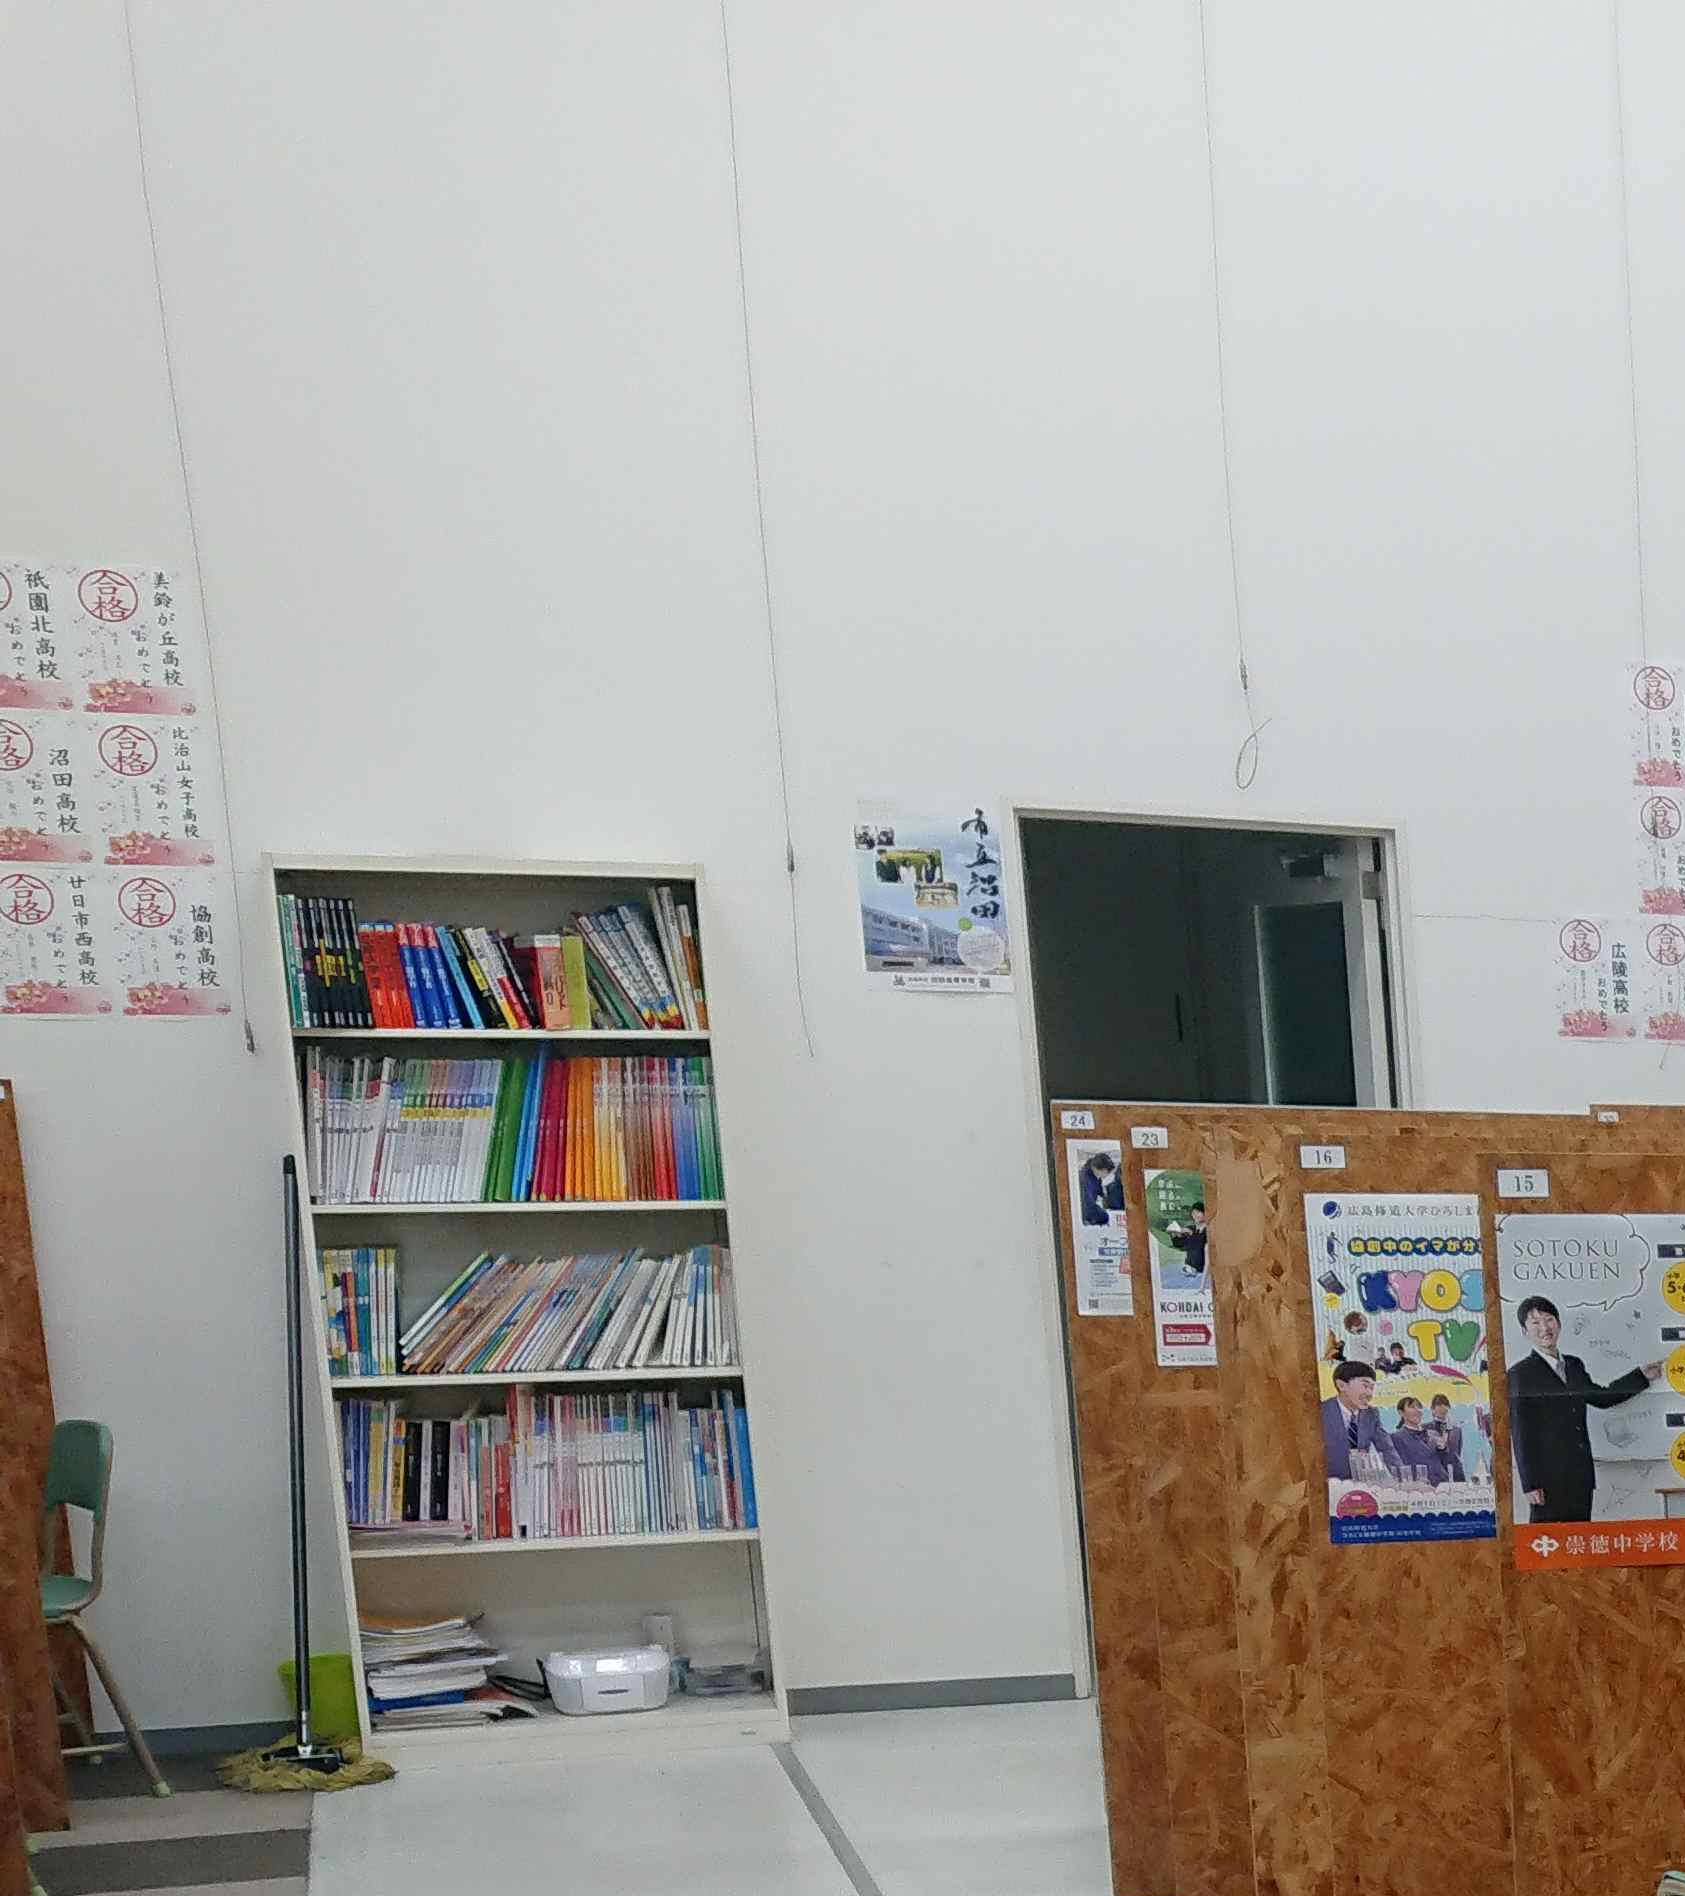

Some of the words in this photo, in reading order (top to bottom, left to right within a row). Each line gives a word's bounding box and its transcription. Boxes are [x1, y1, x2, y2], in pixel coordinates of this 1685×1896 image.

[91, 571, 130, 620] 合格
[25, 569, 62, 680] 祇園北高校
[153, 571, 186, 687] 美鈴が丘高校
[111, 728, 149, 774] 合格
[50, 749, 80, 834] 沼田高校
[172, 727, 200, 839] 比治山女子高校
[961, 808, 1001, 918] 市立沼田
[7, 875, 46, 922] 合格
[131, 879, 168, 926] 合格
[69, 876, 100, 986] 廿日市西高校
[191, 905, 220, 987] 協創高校
[1070, 1115, 1086, 1127] 24
[1141, 1133, 1158, 1146] 23
[1315, 1150, 1333, 1166] 16
[1513, 1174, 1535, 1193] 15
[1512, 1238, 1620, 1259] SOTOKU
[1512, 1261, 1621, 1281] GAKUEN
[1408, 1319, 1480, 1361] TV
[1565, 1530, 1680, 1554] 崇徳中学校
